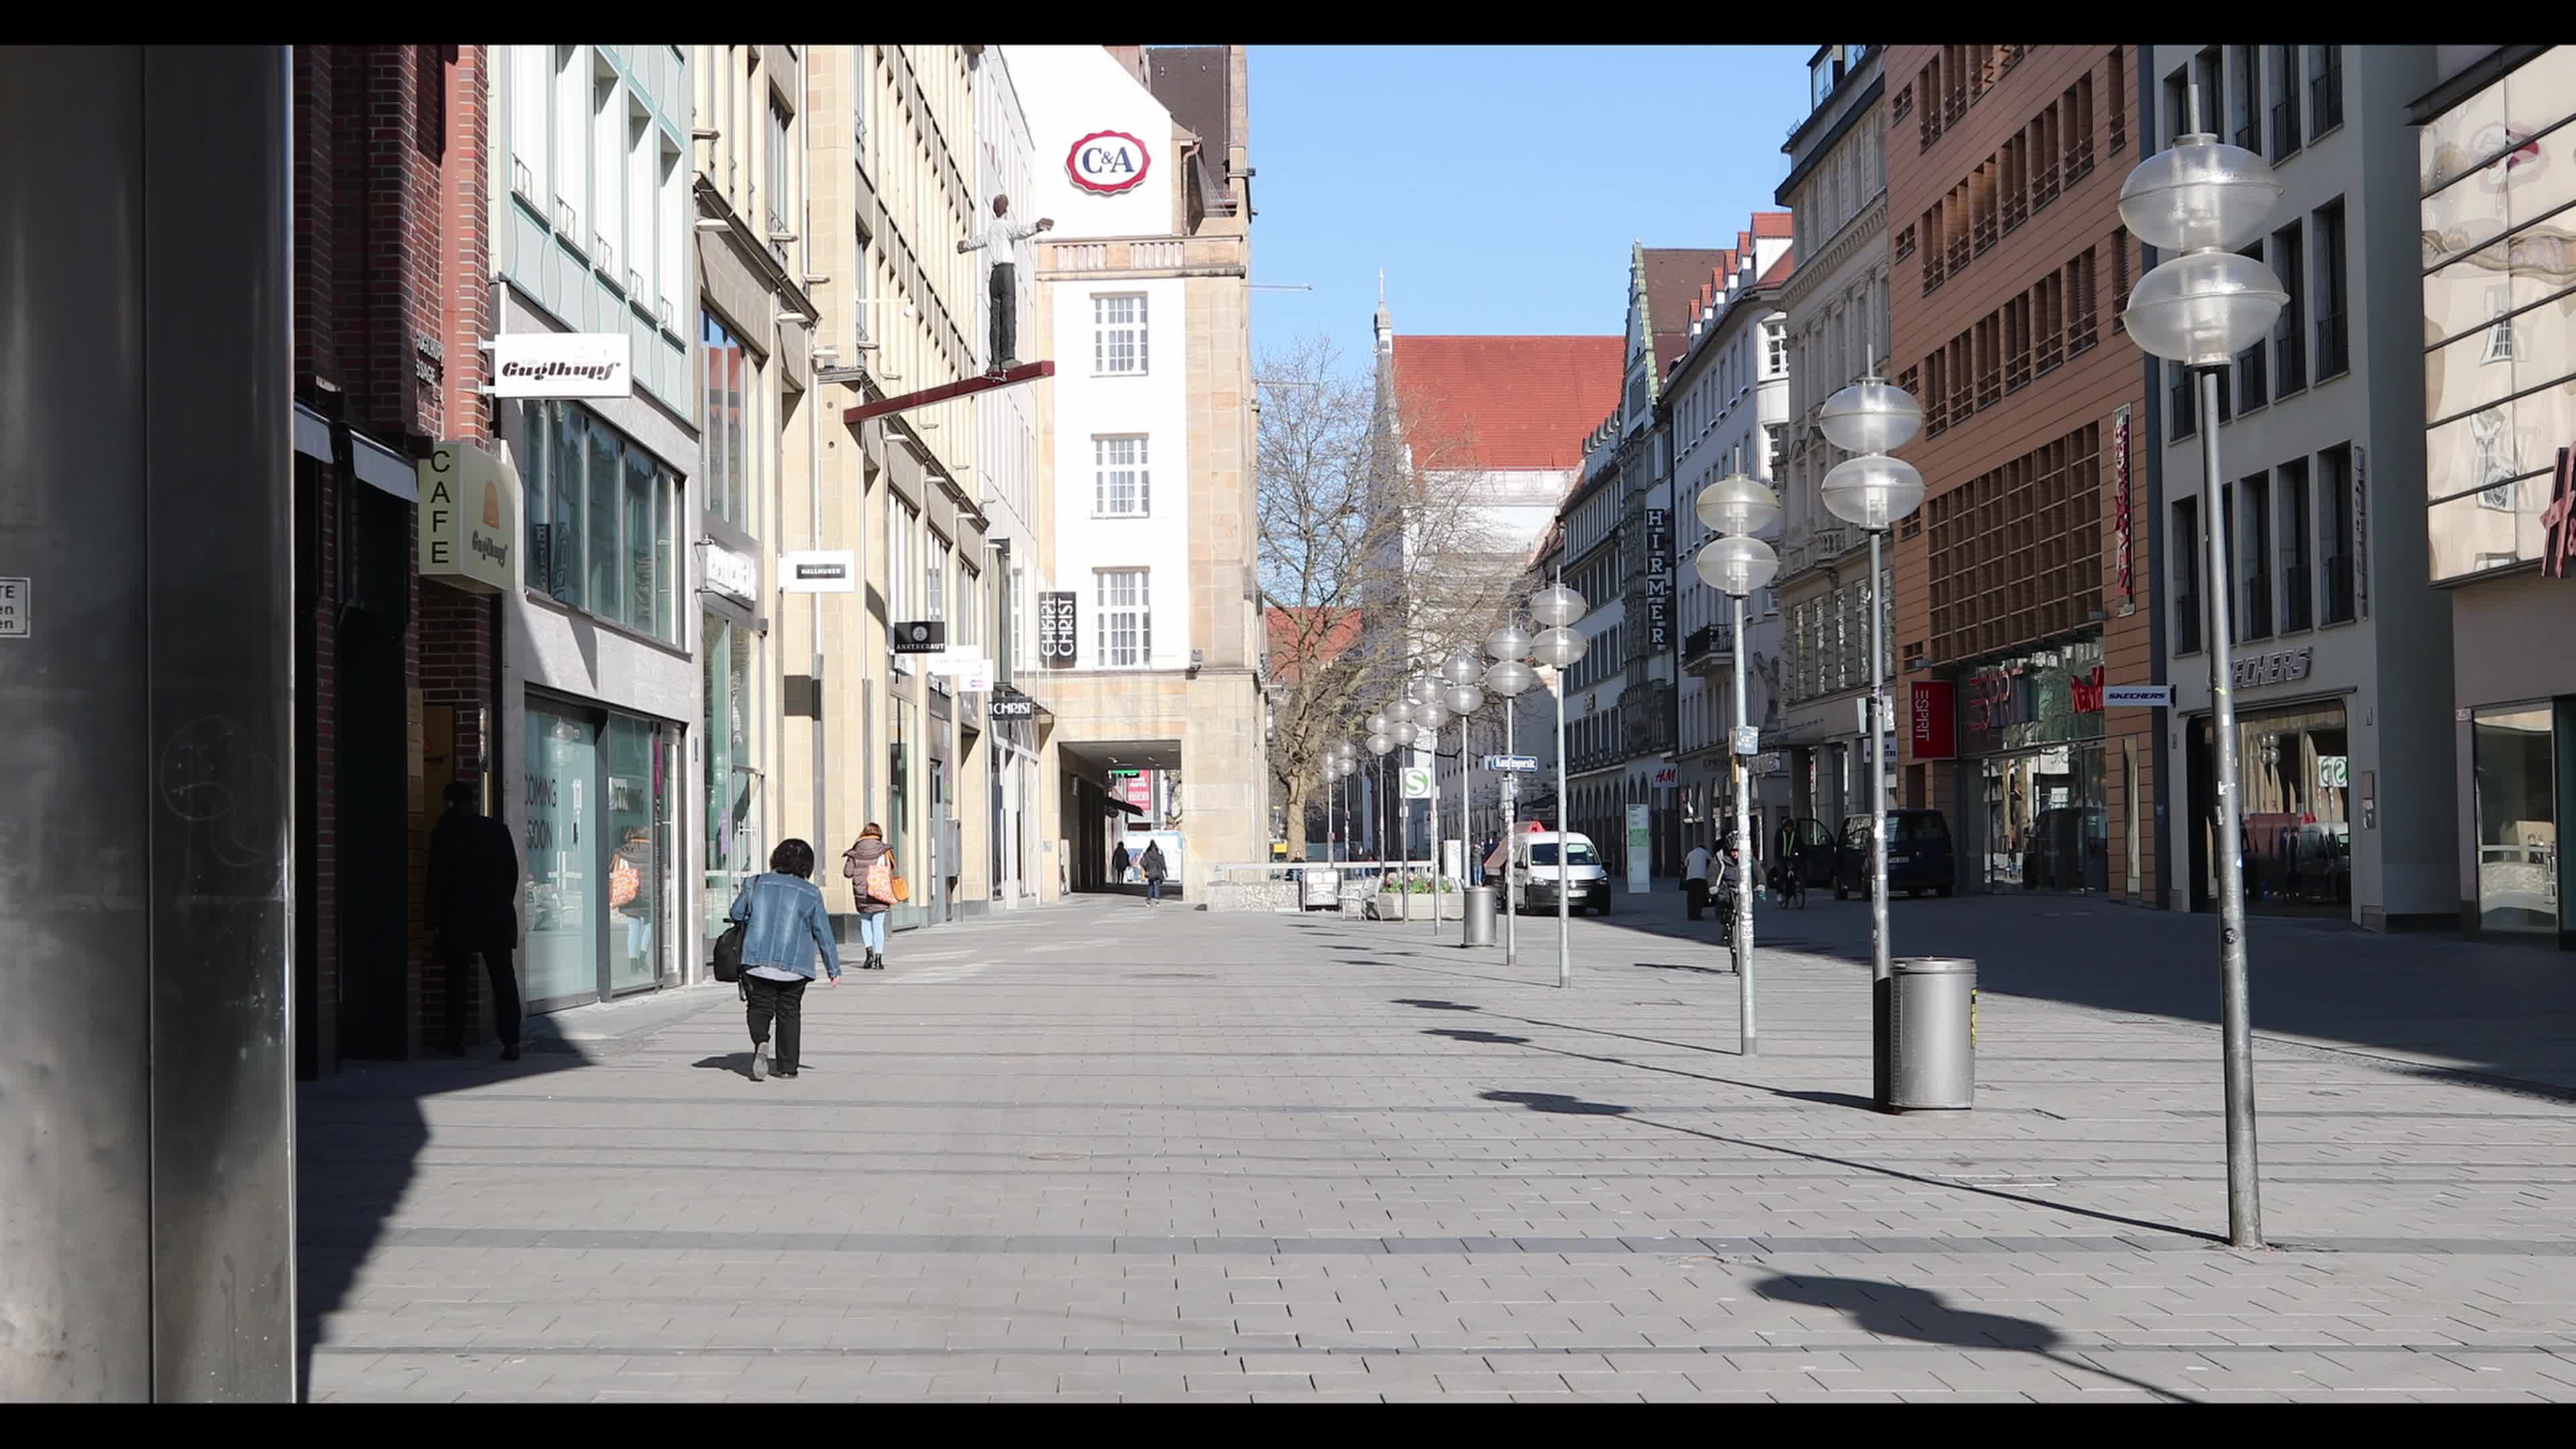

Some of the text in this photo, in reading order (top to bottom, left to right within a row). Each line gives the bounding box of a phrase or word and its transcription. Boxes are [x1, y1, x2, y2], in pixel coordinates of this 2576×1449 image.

[1083, 146, 1135, 174] C&A
[502, 362, 621, 381] Guglhupf
[1648, 511, 1665, 643] HIRMER
[1058, 598, 1074, 656] CHRIST
[994, 702, 1031, 714] CHRIST
[1915, 689, 1930, 742] ESPRIT
[527, 819, 553, 849] SOON
